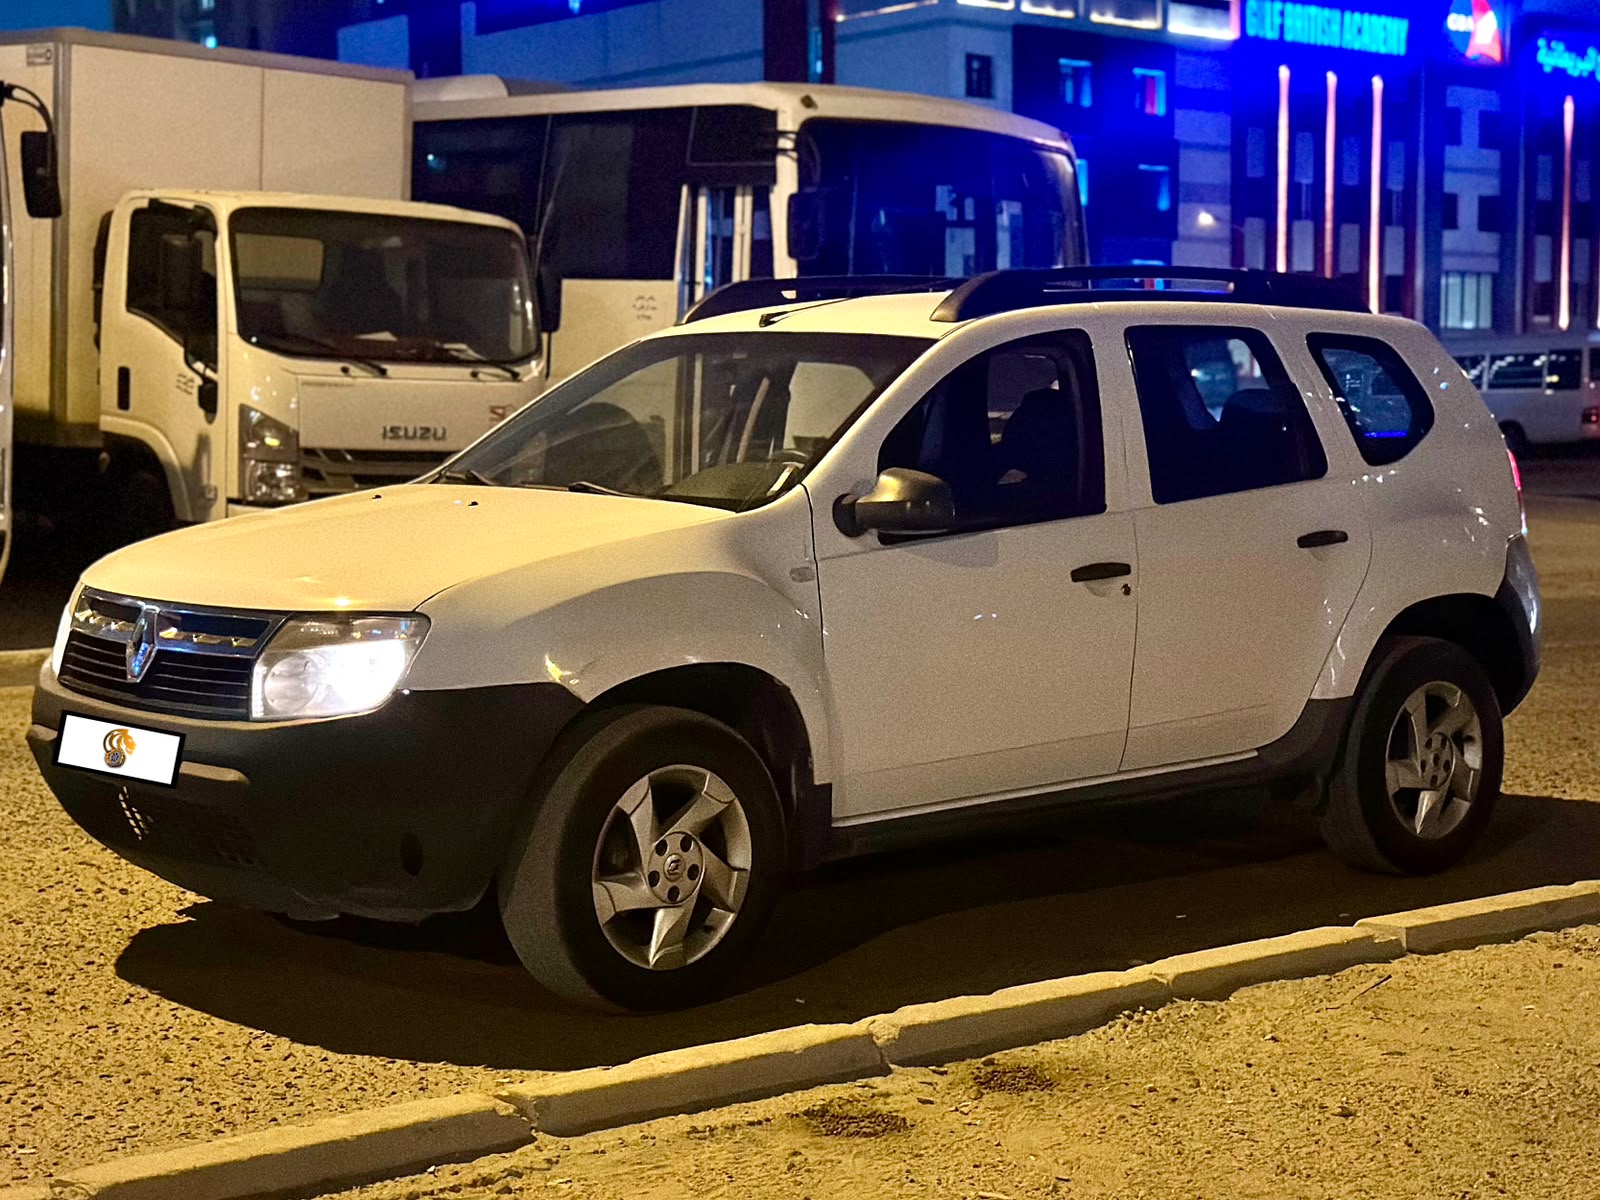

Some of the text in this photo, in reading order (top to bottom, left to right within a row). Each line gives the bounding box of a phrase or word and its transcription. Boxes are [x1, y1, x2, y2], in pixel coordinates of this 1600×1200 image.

[1245, 0, 1409, 56] GULF BRITISH ACADEMY
[382, 425, 447, 441] ISUZU
